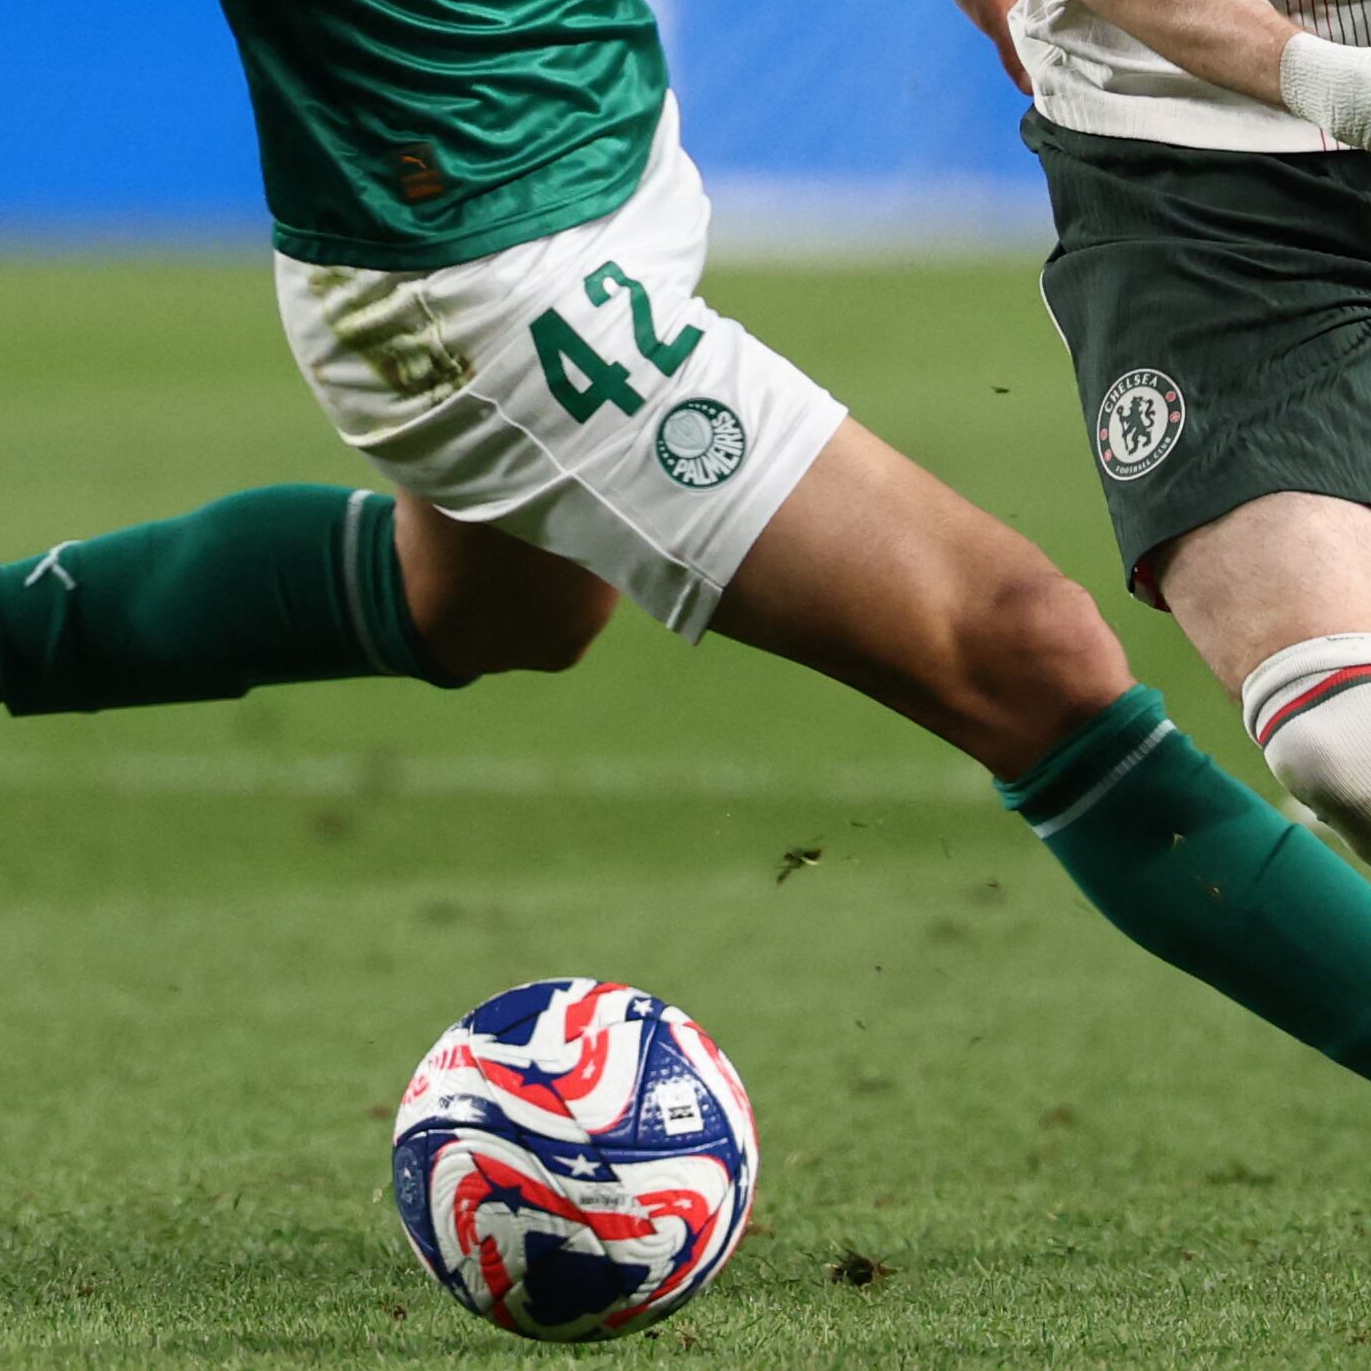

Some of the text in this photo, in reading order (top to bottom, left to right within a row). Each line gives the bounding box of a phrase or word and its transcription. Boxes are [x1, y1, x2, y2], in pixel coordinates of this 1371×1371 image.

[529, 260, 705, 425] 42
[1104, 373, 1158, 413] CHELSEA
[672, 411, 744, 486] PALMEIRAS
[1116, 436, 1172, 474] FOOTBALL CLUB
